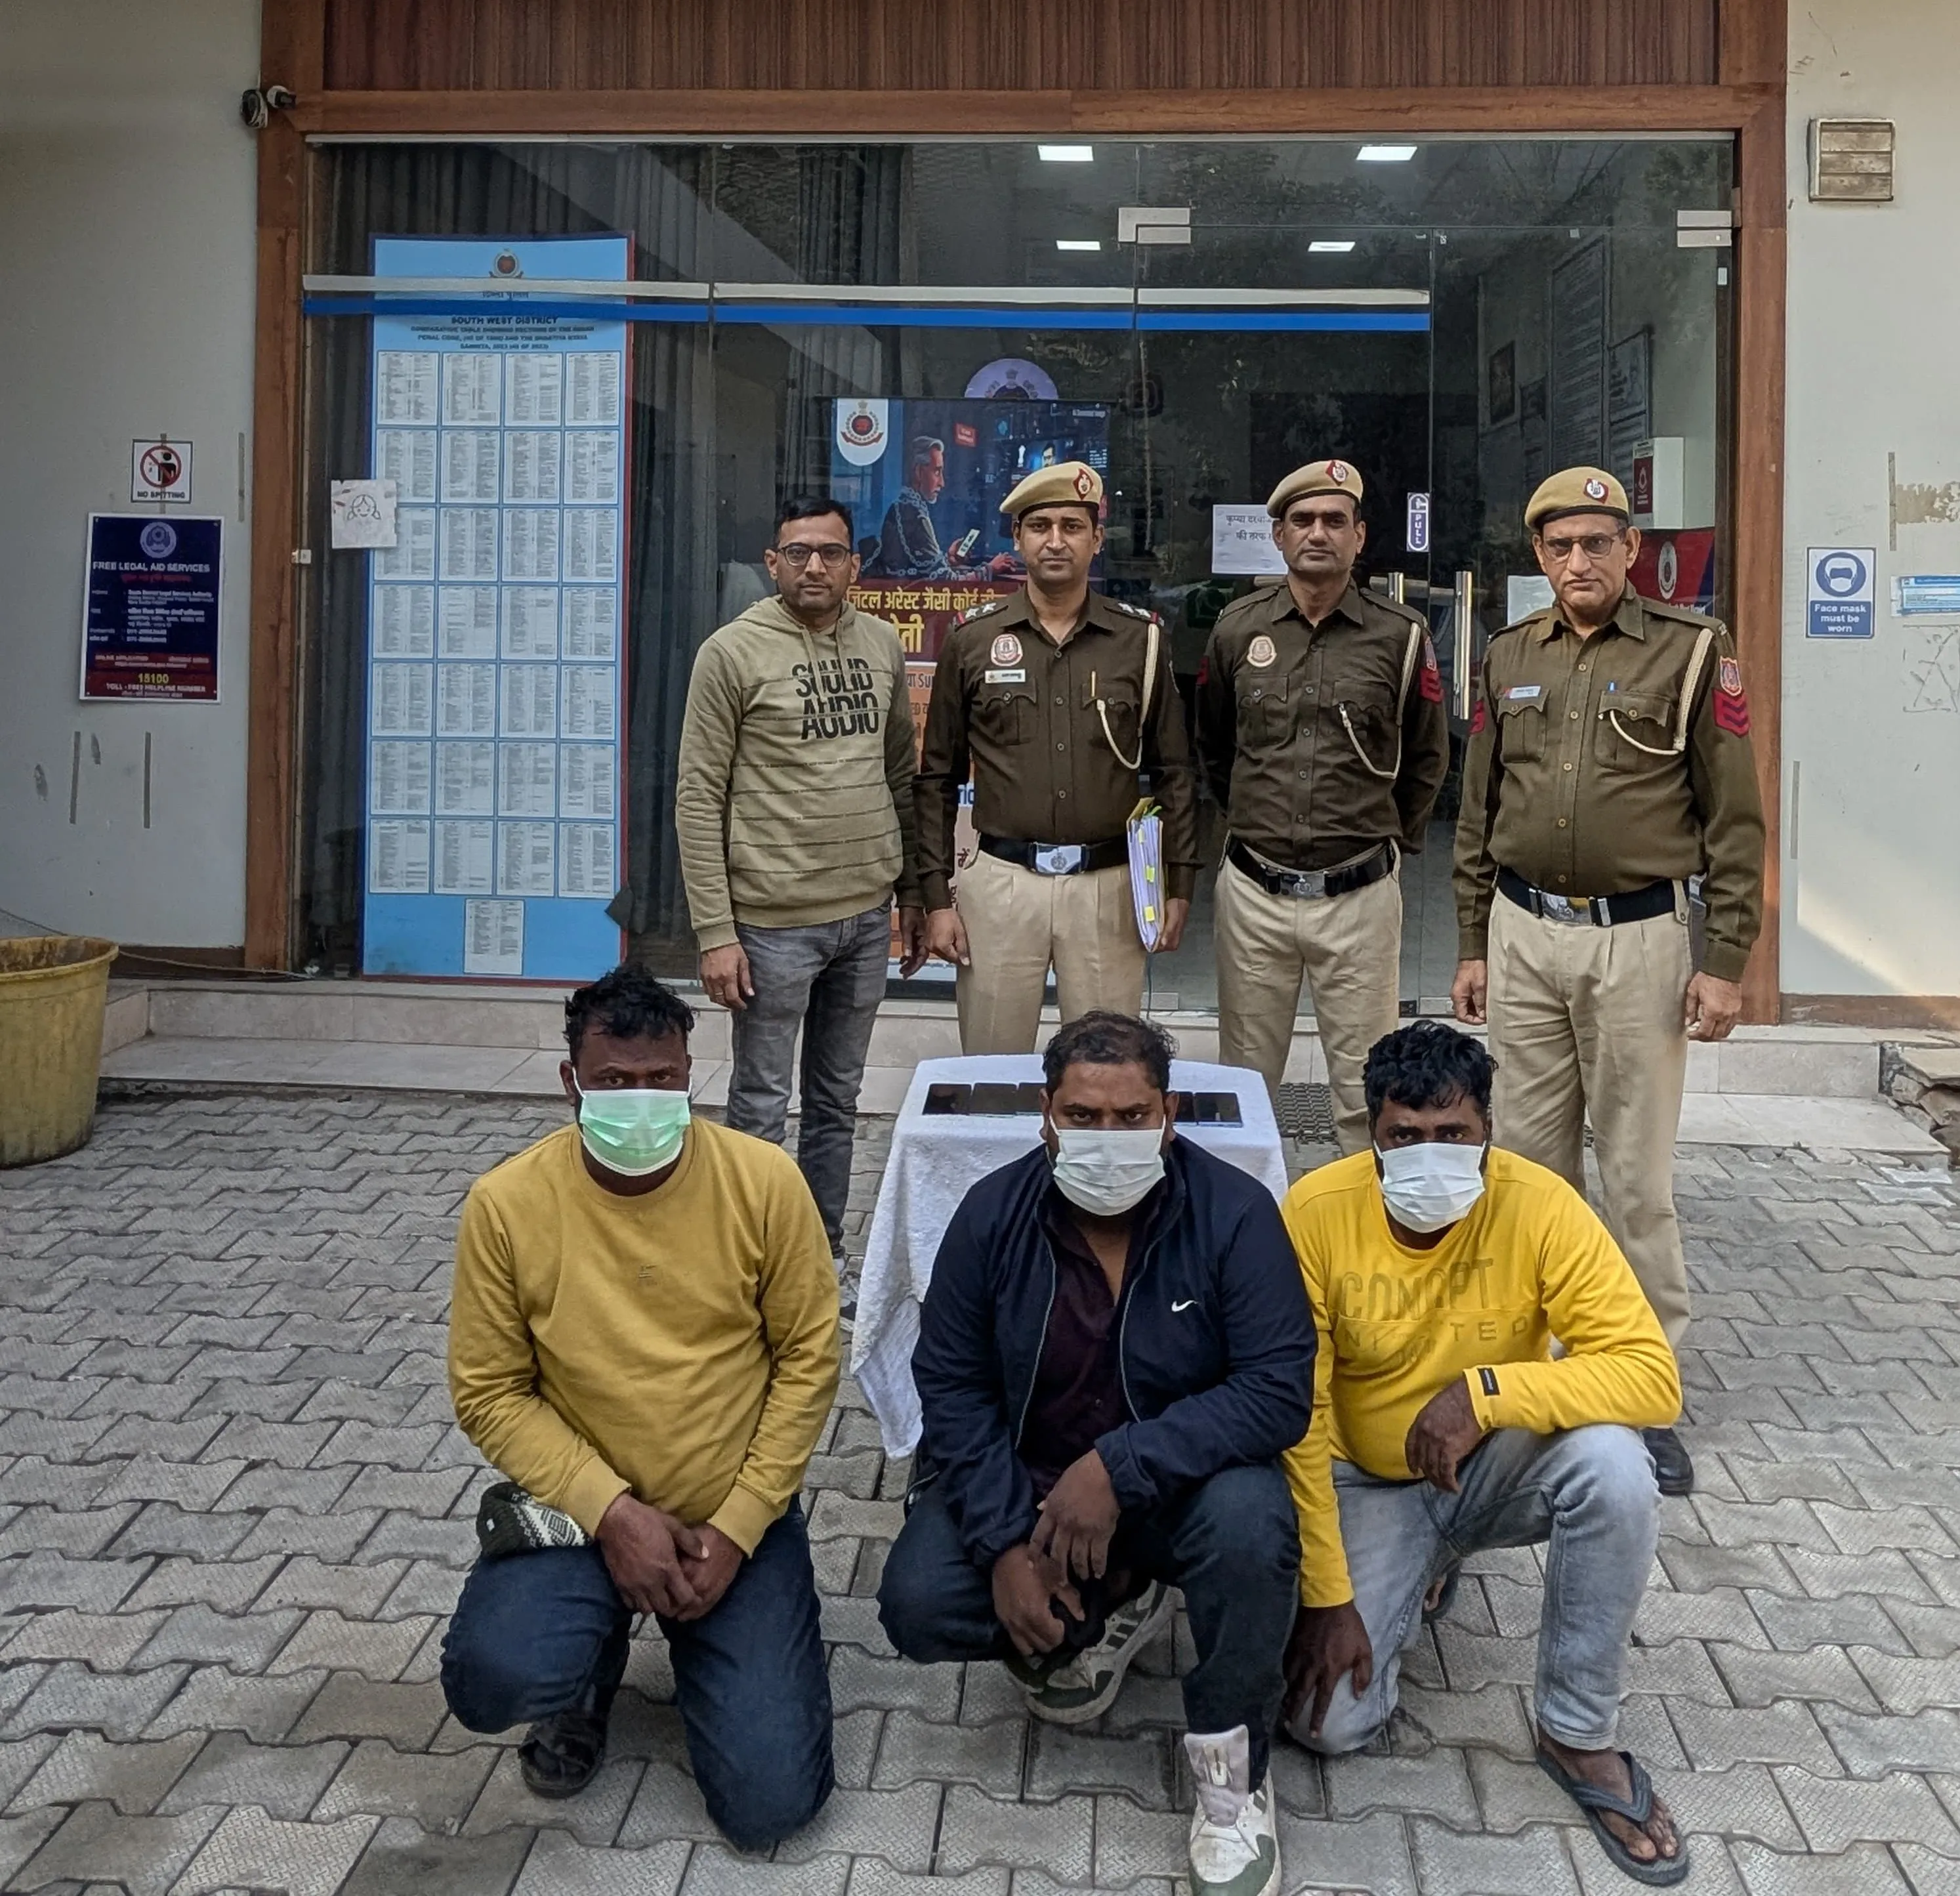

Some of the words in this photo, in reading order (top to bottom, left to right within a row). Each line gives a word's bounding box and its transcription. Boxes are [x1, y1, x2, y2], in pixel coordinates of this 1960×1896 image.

[515, 316, 556, 325] DISTRICT
[93, 561, 117, 570] FREE
[119, 562, 148, 571] LEGAL
[150, 562, 166, 572] AID
[167, 563, 211, 573] SERVICES
[922, 586, 951, 611] जैसी
[1814, 604, 1838, 613] Face
[1839, 604, 1867, 613] mask
[1820, 614, 1846, 623] must
[1847, 614, 1860, 623] be
[801, 691, 879, 740] AUDIO
